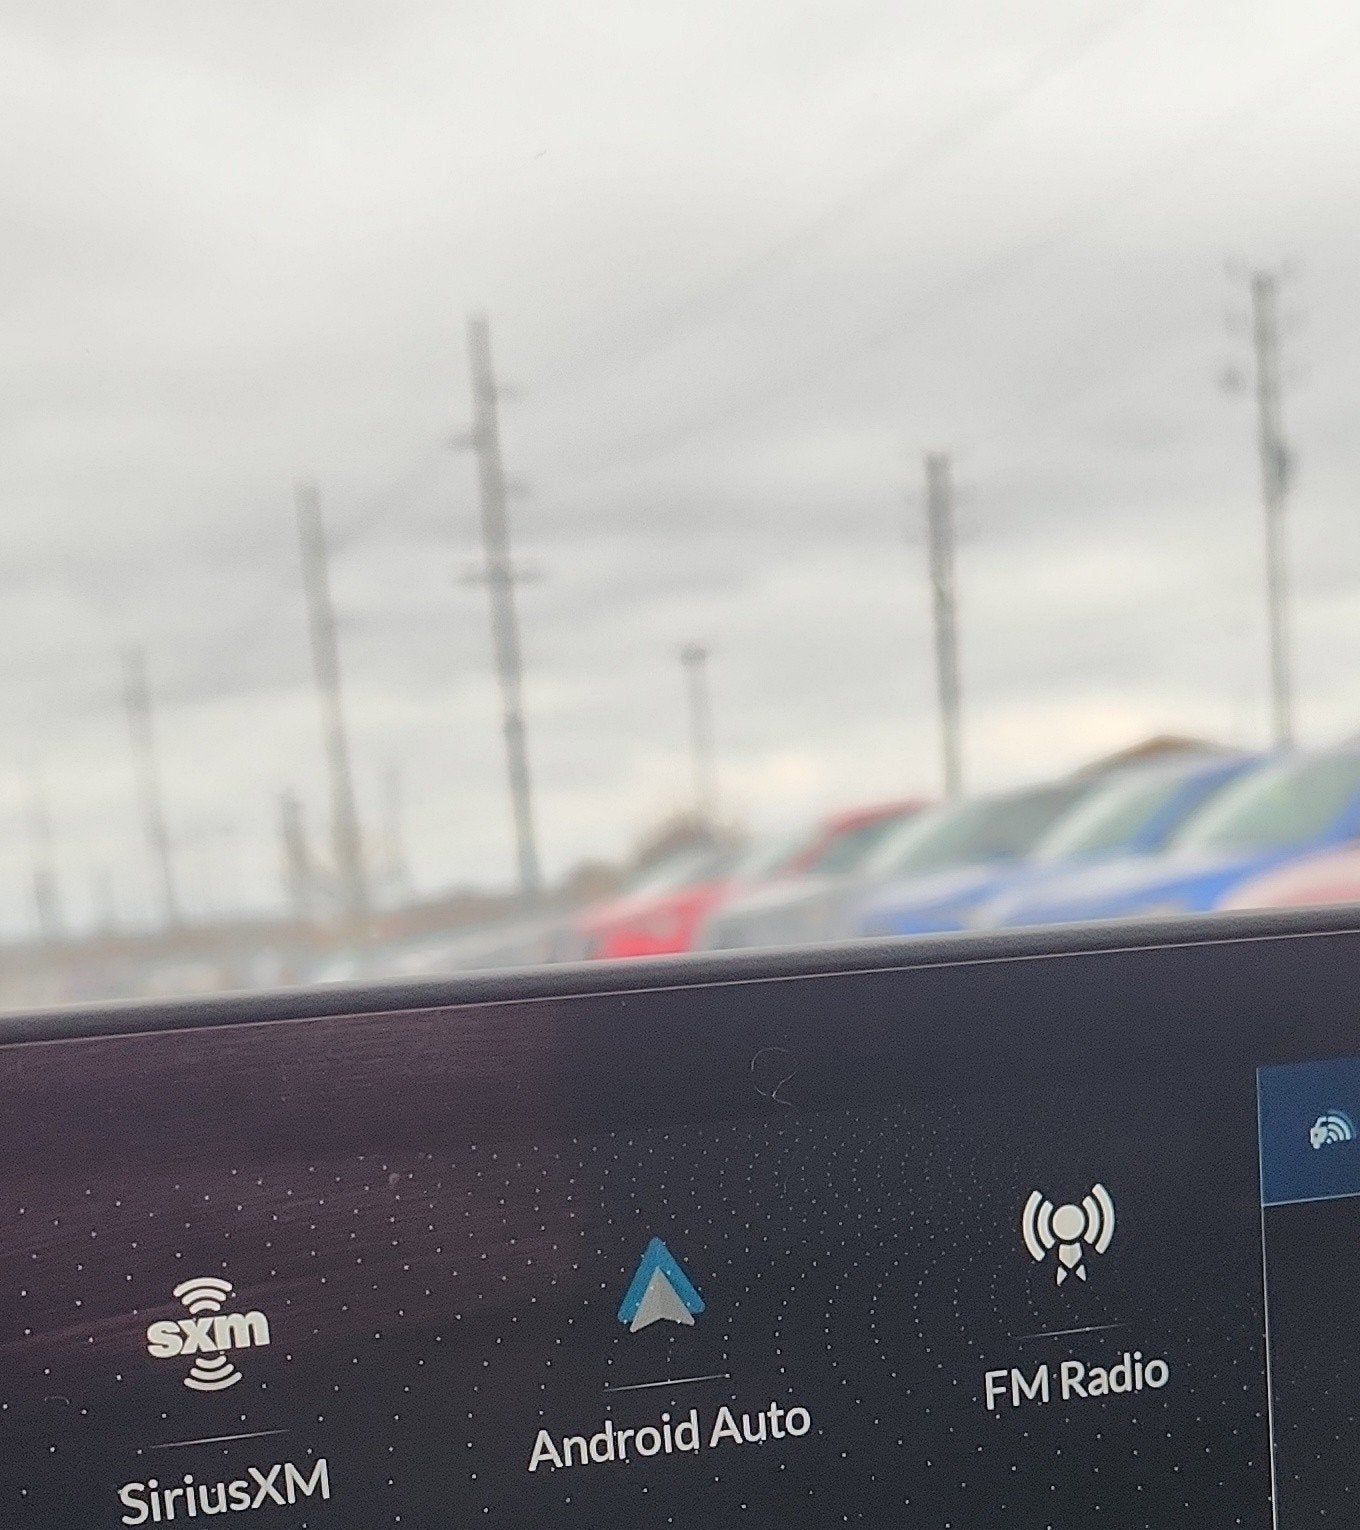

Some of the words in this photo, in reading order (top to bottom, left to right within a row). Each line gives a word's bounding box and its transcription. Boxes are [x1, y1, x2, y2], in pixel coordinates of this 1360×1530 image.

[146, 1311, 271, 1358] sxm
[984, 1364, 1050, 1411] FM
[1060, 1351, 1169, 1400] Radio
[528, 1409, 700, 1472] Android
[709, 1401, 811, 1448] Auto
[117, 1458, 330, 1525] SiriusXM
